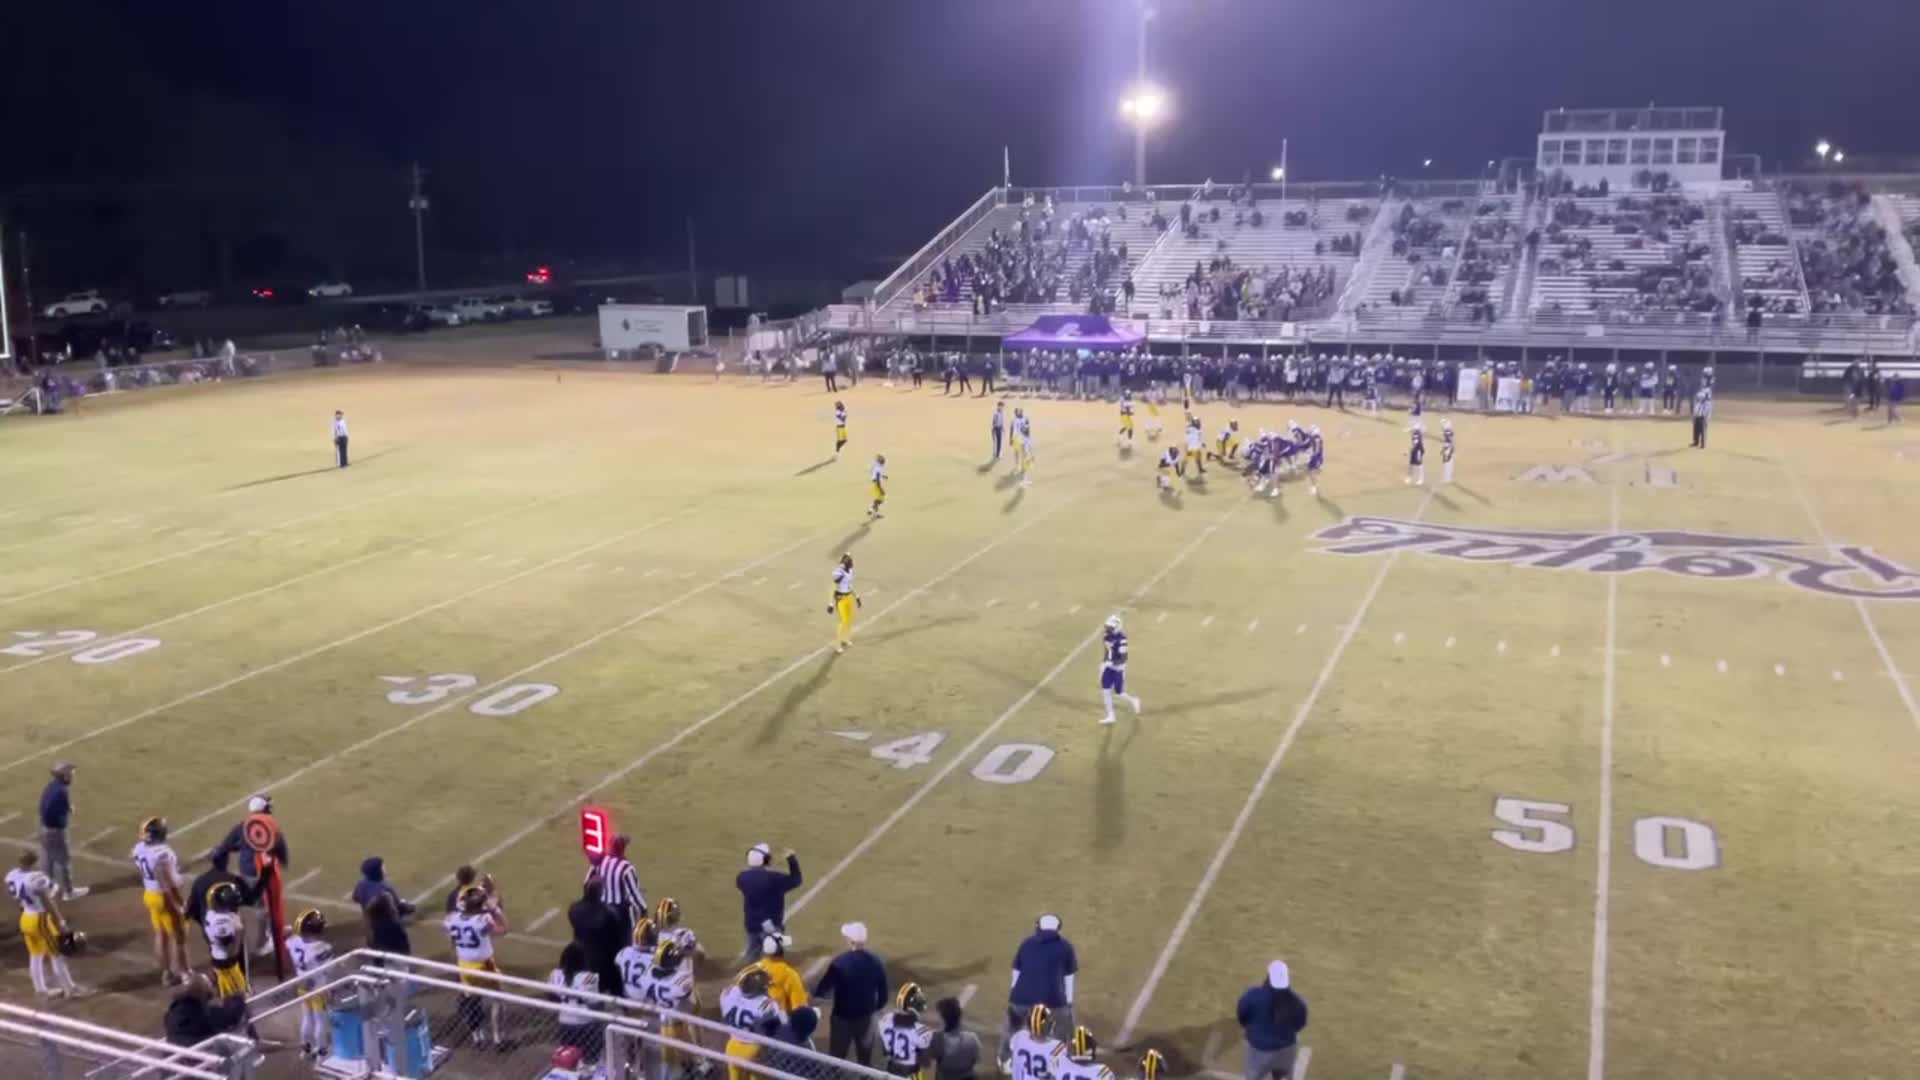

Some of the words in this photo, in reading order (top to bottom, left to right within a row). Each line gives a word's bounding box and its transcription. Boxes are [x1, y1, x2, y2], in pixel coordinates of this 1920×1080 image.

[584, 812, 604, 854] 3
[450, 925, 480, 949] 23
[624, 959, 646, 989] 12
[646, 983, 675, 1009] 45
